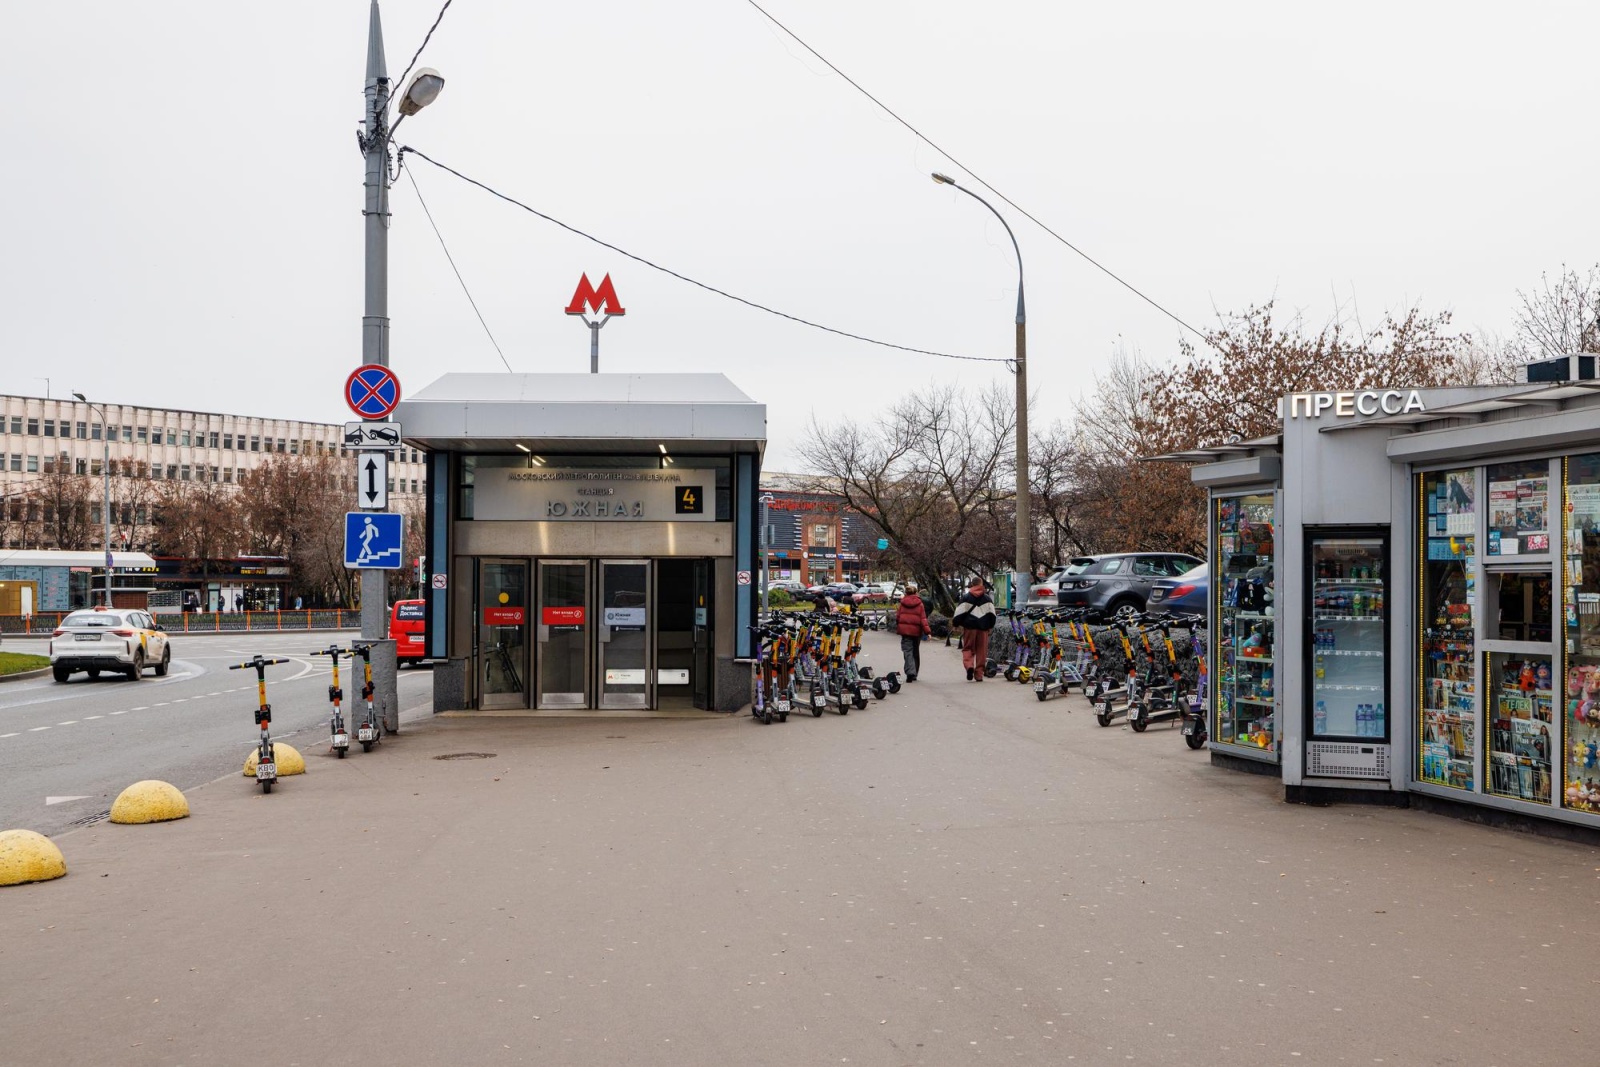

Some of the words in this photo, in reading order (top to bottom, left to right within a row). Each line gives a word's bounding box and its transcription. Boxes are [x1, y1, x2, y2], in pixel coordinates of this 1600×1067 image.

[1291, 390, 1426, 418] ПРЕССА
[508, 472, 564, 481] МОСКОВСКИЙ
[566, 472, 622, 481] МЕТРОПОЛИТЕН
[577, 487, 614, 496] СТАНЦИЯ
[682, 488, 696, 505] 4
[547, 500, 645, 517] ЮЖНАЯ
[1506, 700, 1530, 710] ТЕЛЕК
